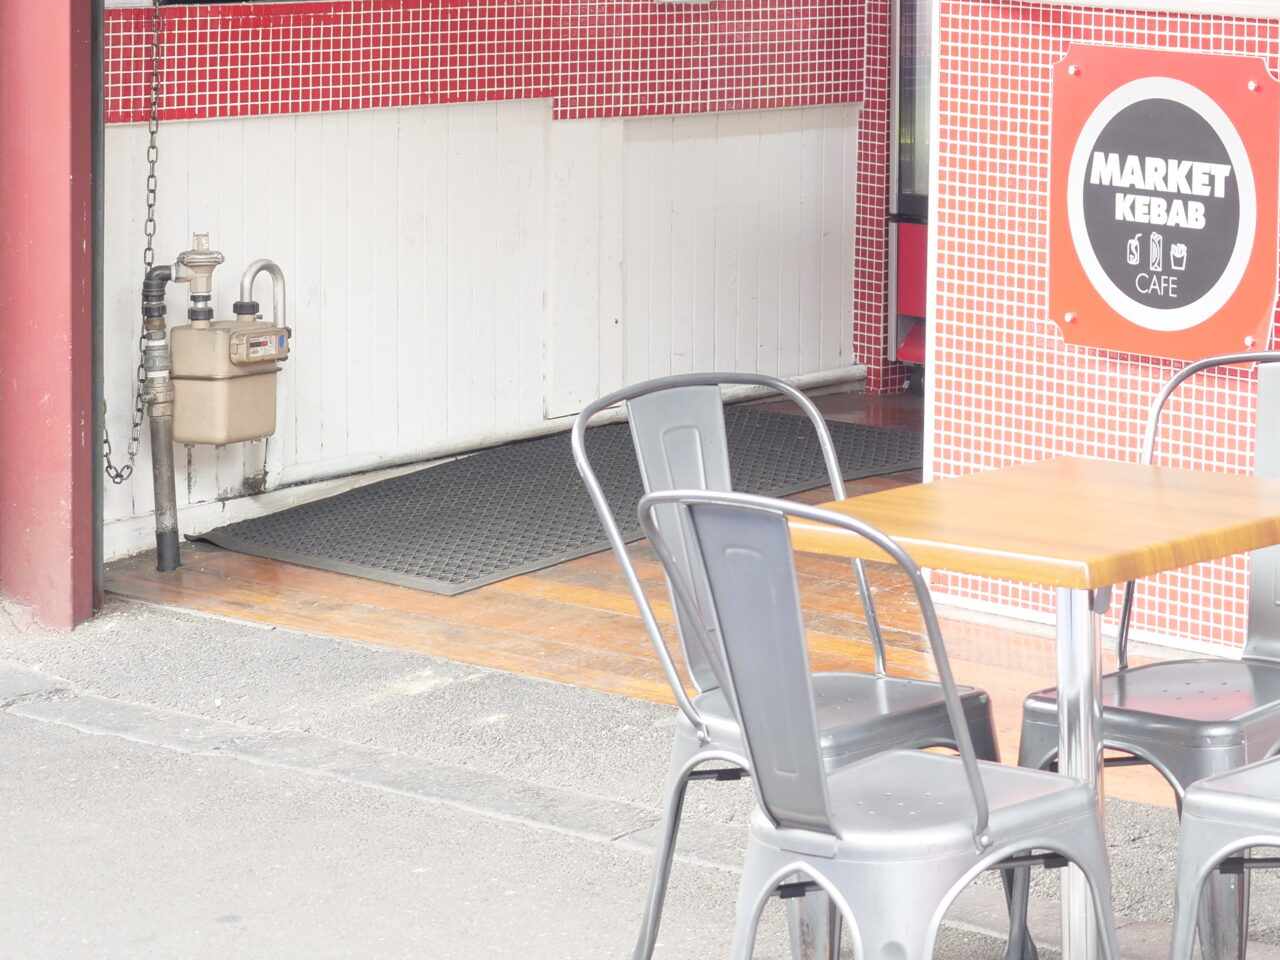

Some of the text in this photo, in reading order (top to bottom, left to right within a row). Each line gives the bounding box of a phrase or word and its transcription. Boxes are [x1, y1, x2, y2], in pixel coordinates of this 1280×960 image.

[1089, 150, 1232, 199] MARKET
[1114, 193, 1206, 230] KEBAB
[1135, 272, 1179, 298] CAFE
